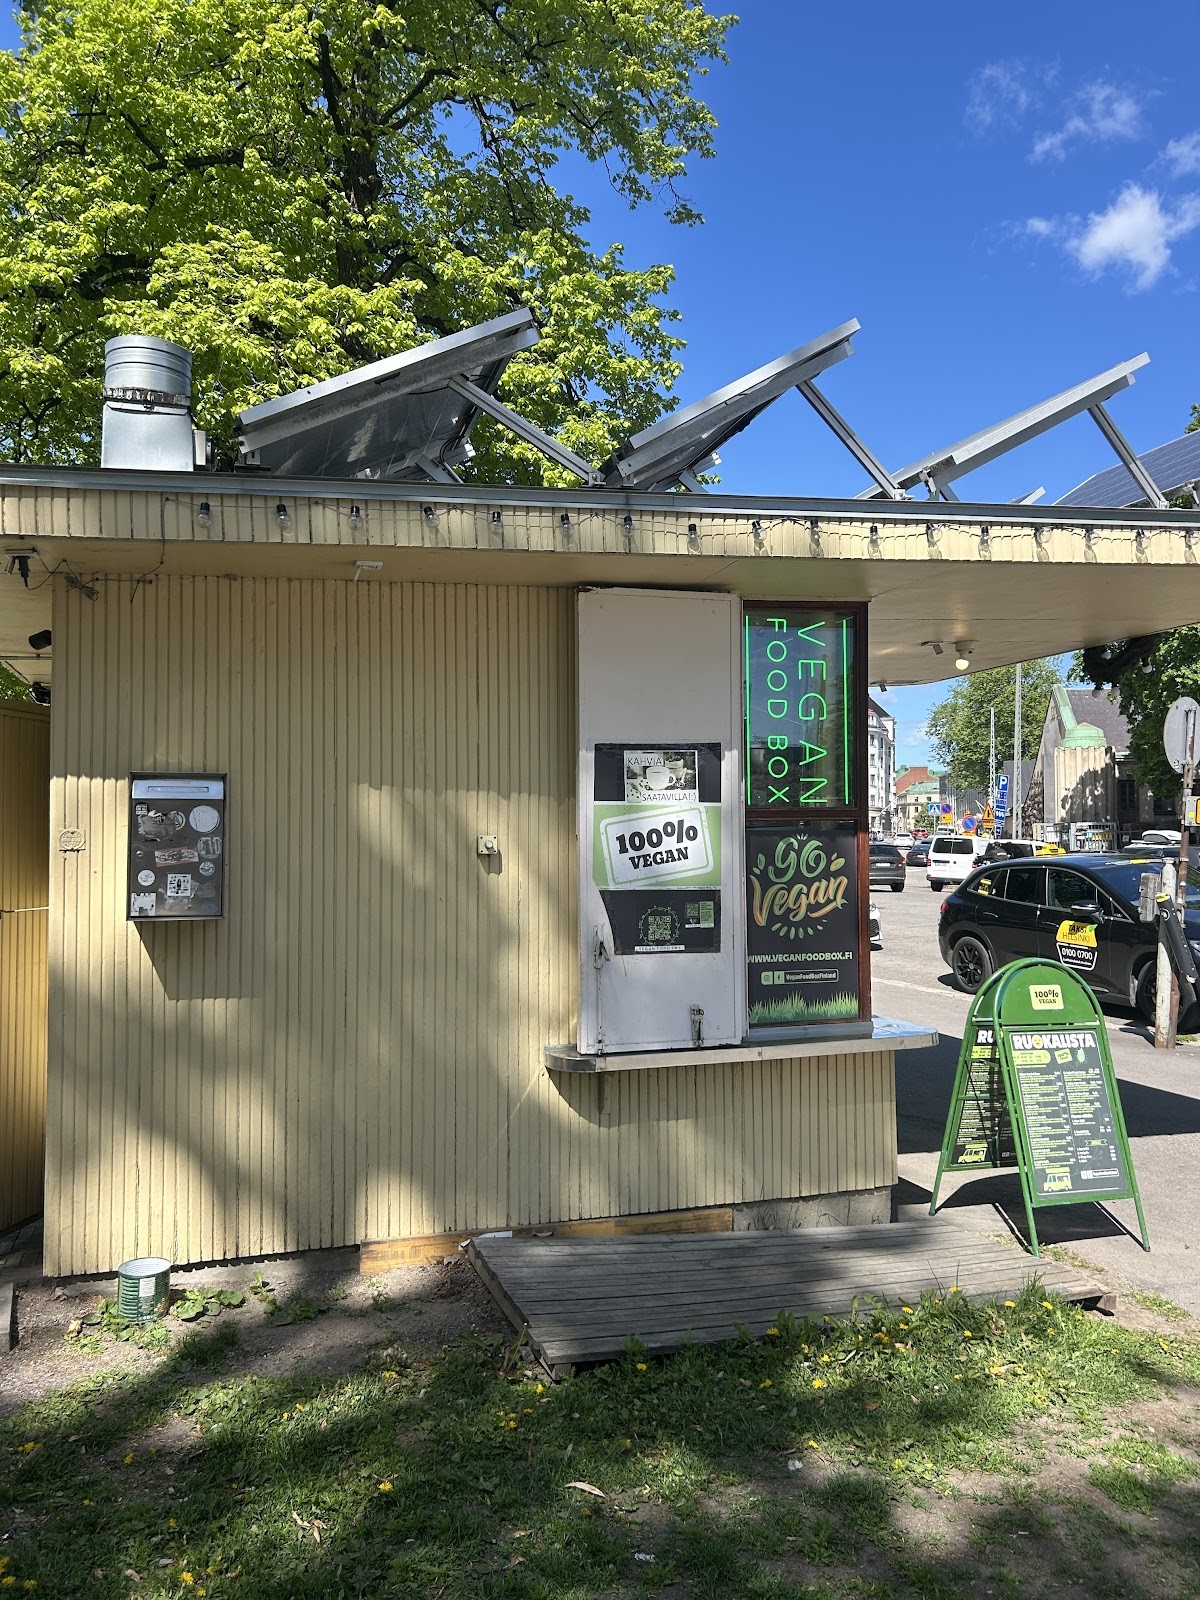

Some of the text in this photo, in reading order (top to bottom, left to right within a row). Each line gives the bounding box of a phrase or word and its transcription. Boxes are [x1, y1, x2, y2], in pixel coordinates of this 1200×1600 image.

[766, 618, 790, 803] FOOD BOX
[798, 621, 828, 803] VEGAN
[627, 757, 662, 766] KAHVIA
[999, 776, 1008, 790] P
[615, 819, 698, 855] 100%
[628, 846, 689, 870] VEGAN
[749, 875, 848, 927] Vegan
[1068, 924, 1087, 934] TAKSI
[1062, 932, 1091, 943] HELSINKI
[747, 951, 853, 964] WWW.VEGANFOODBOX.FI
[1061, 947, 1093, 960] 0100 0700
[1034, 989, 1059, 998] 100%
[1012, 1033, 1096, 1050] RUOKALISTA
